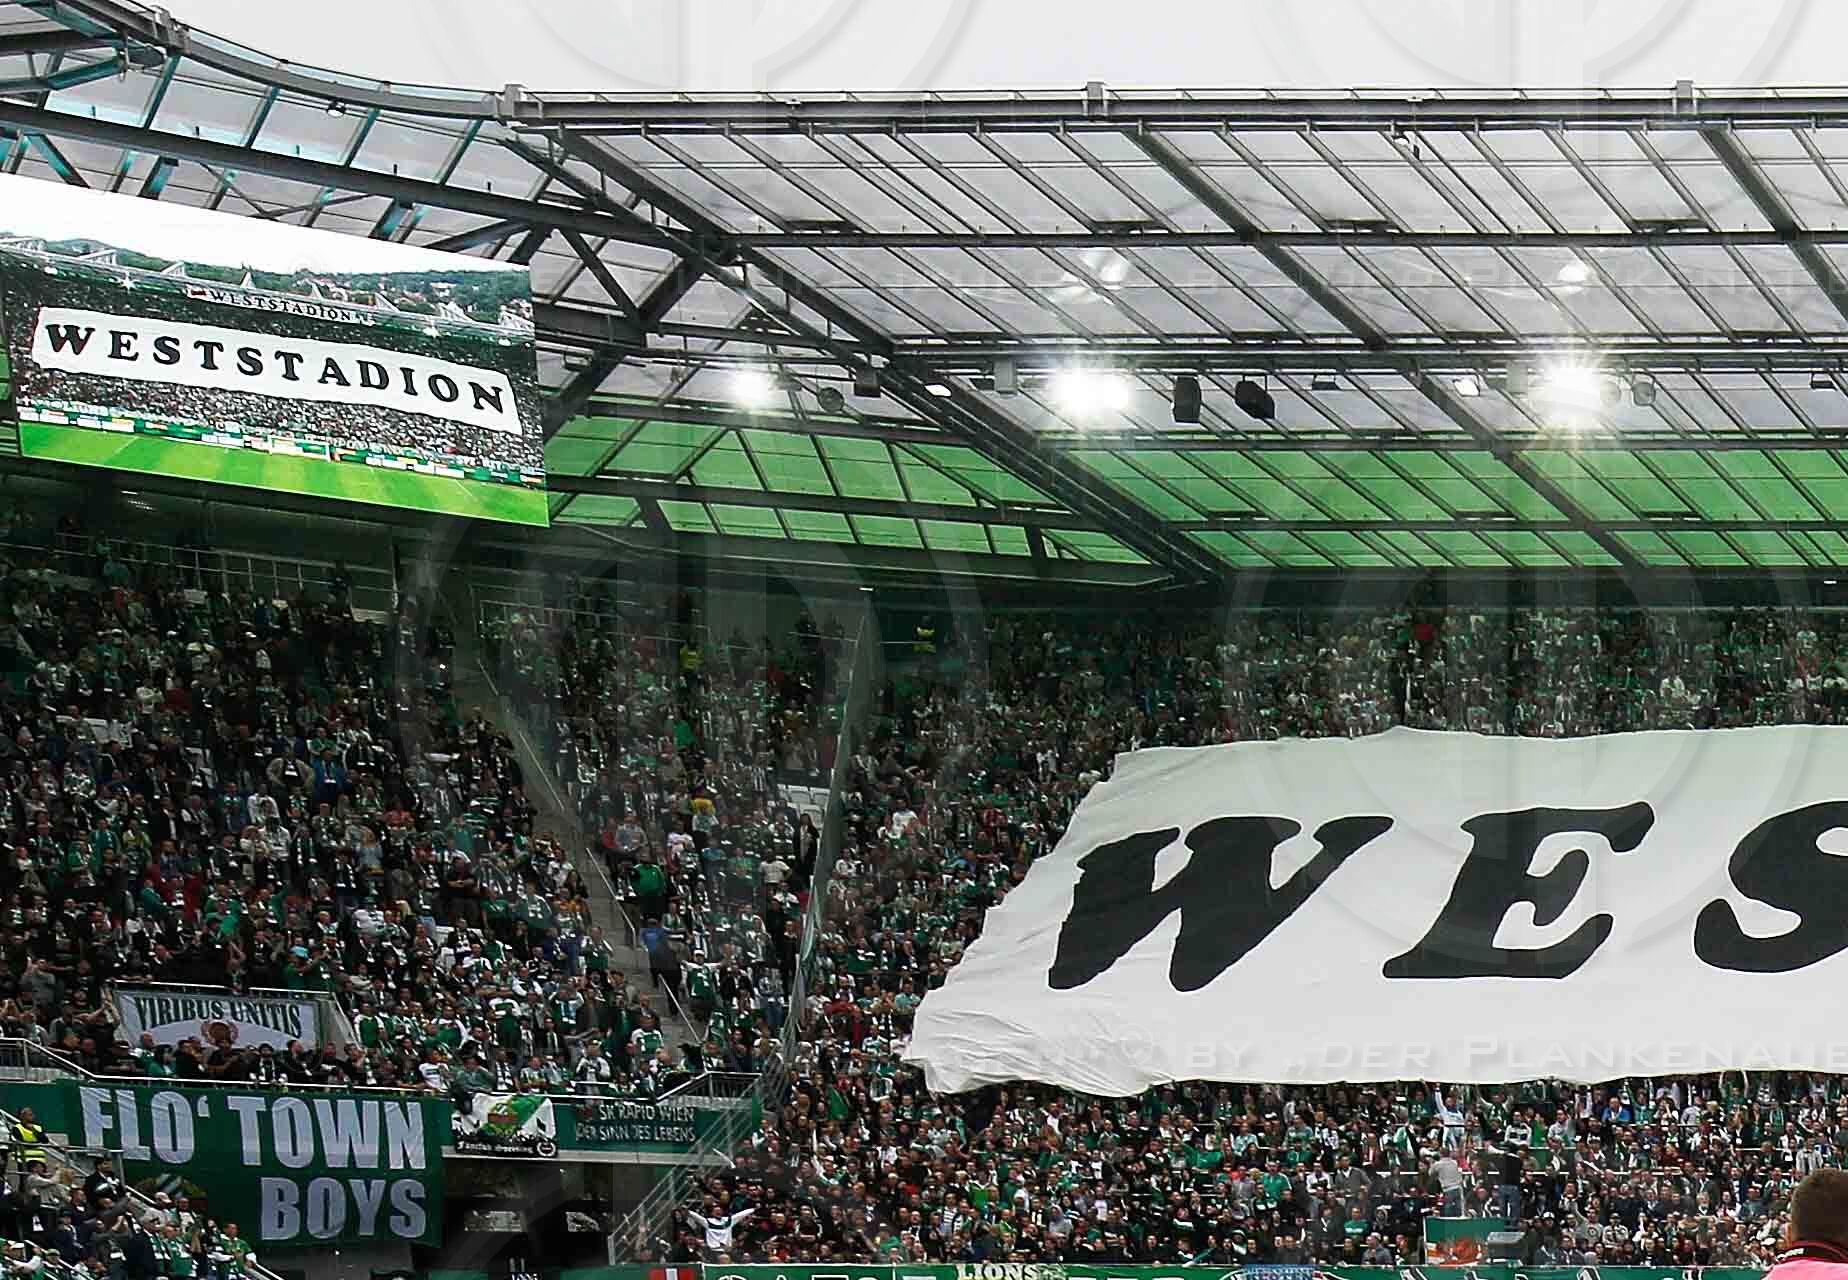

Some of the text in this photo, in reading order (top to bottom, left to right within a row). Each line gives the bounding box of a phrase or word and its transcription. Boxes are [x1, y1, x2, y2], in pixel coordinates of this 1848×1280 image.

[210, 288, 352, 322] WESTSTADION
[46, 322, 504, 415] WESTSTADION
[135, 997, 303, 1039] VIRIBUS UNITIS
[228, 1094, 428, 1170] TOWN
[660, 1105, 694, 1122] WIEN
[260, 1175, 427, 1242] BOYS
